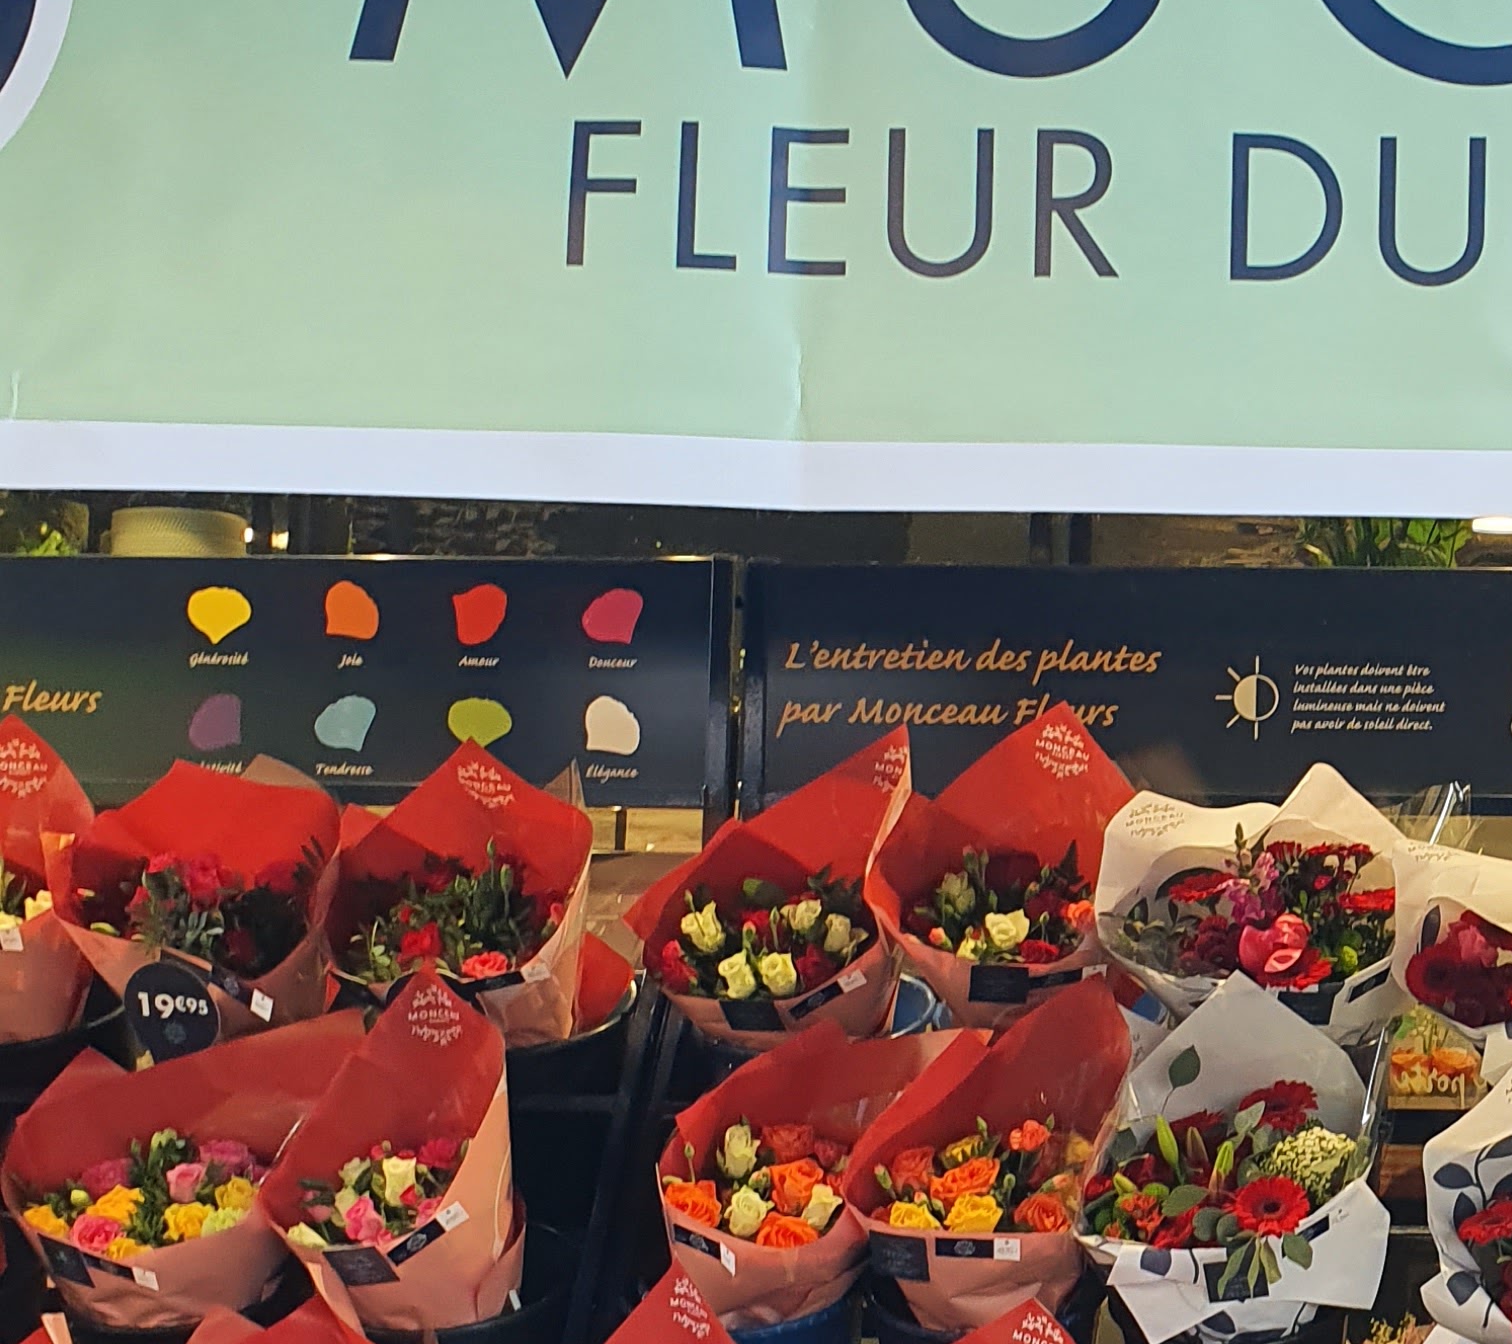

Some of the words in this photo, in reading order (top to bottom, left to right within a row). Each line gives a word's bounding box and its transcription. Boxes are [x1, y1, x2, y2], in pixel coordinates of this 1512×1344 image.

[566, 120, 1119, 279] FLEUR
[1230, 133, 1488, 287] DU
[337, 653, 363, 670] Joie
[458, 655, 500, 667] Amour
[588, 655, 638, 668] Douceur
[784, 639, 971, 672] L'entretien
[975, 638, 1027, 672] des
[1032, 639, 1162, 686] plantes
[1295, 664, 1314, 676] Vos
[1314, 662, 1358, 679] plantes
[1360, 662, 1404, 676] doivent
[1350, 681, 1378, 694] dans
[1380, 685, 1402, 694] une
[1, 679, 102, 714] Fleurs
[1355, 700, 1381, 712] mais
[1386, 703, 1401, 712] ne
[1402, 699, 1446, 713] doivent
[776, 700, 842, 738] par
[849, 697, 1007, 725] Monceau
[1013, 693, 1119, 726] Flurs
[1291, 720, 1311, 734] pas
[1314, 717, 1346, 729] avoir
[1347, 716, 1362, 730] de
[1364, 717, 1394, 730] soleil
[316, 762, 374, 776] Tendresse
